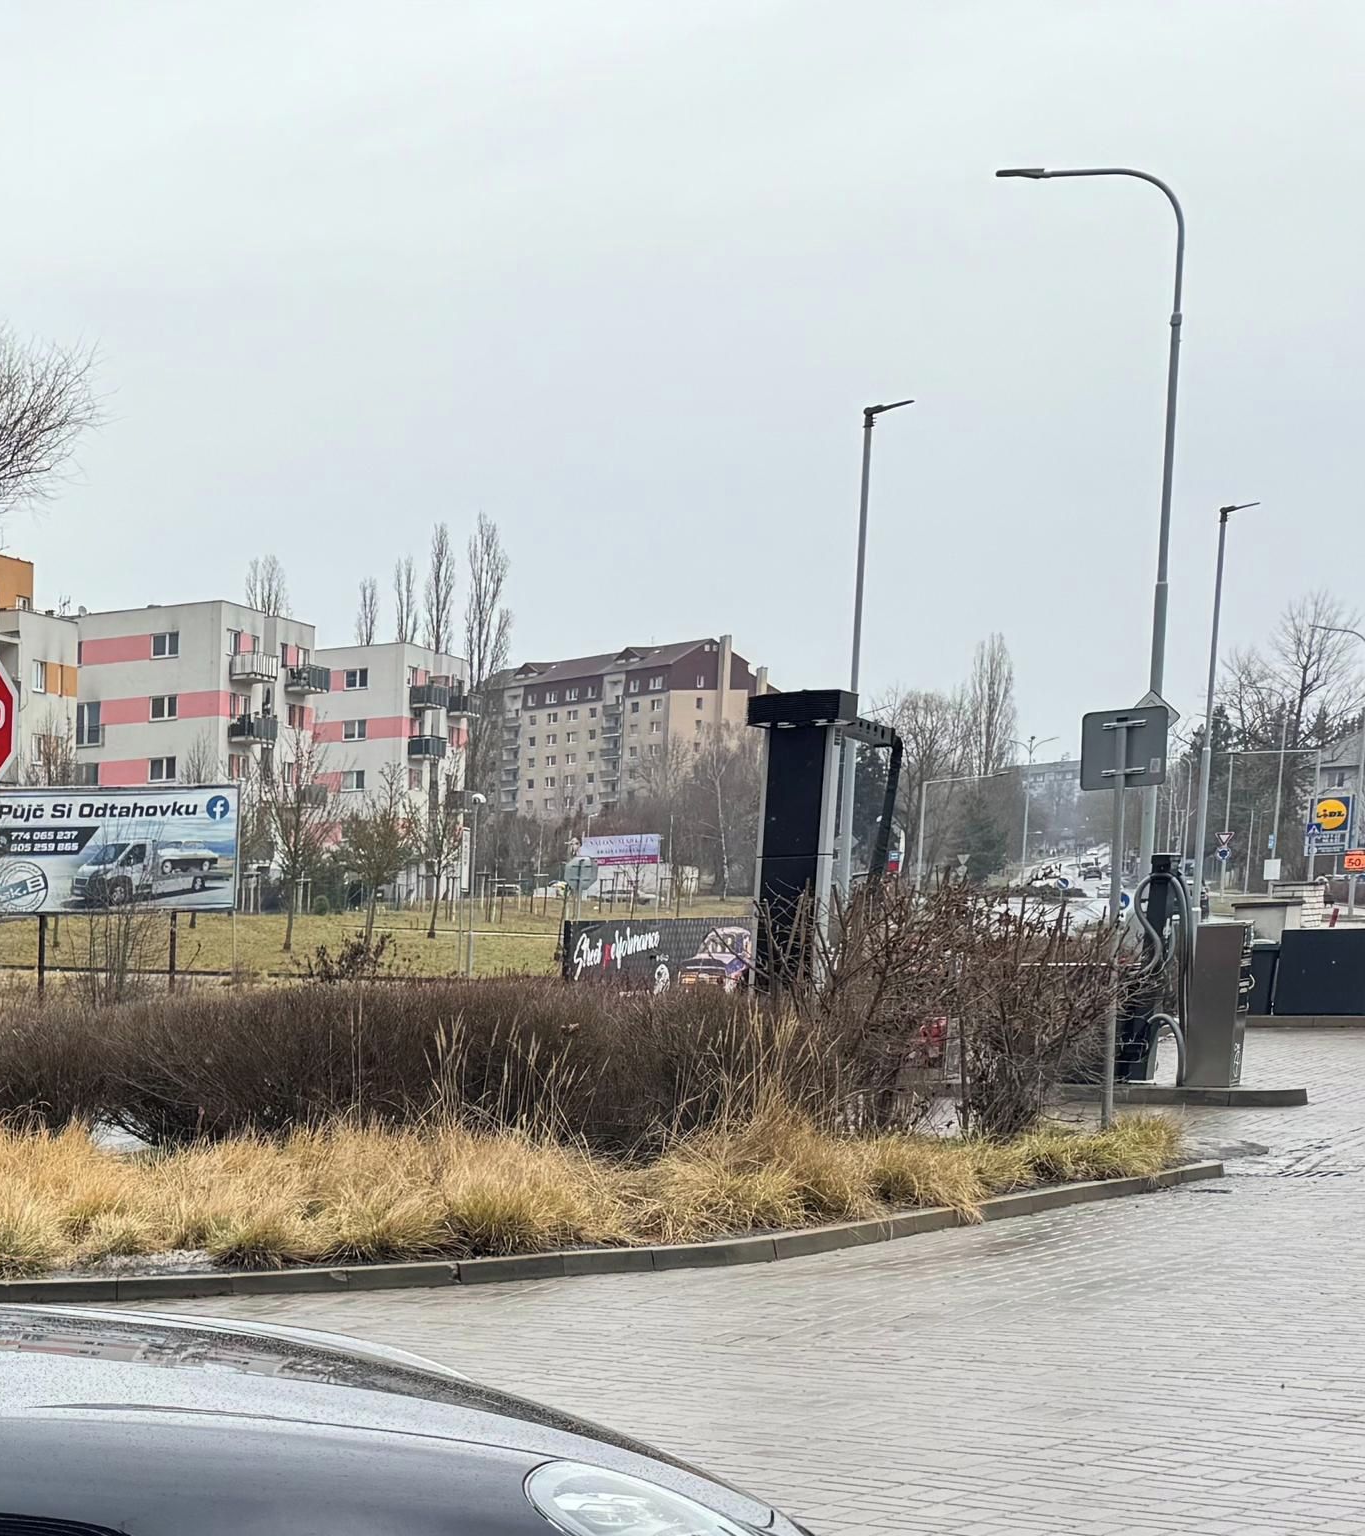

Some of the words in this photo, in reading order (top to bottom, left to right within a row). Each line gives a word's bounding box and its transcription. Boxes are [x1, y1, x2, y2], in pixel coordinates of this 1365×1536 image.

[50, 803, 74, 819] Si
[78, 801, 198, 819] Odtahovku
[10, 831, 31, 841] 774
[56, 830, 79, 840] 237
[573, 933, 603, 980] Street
